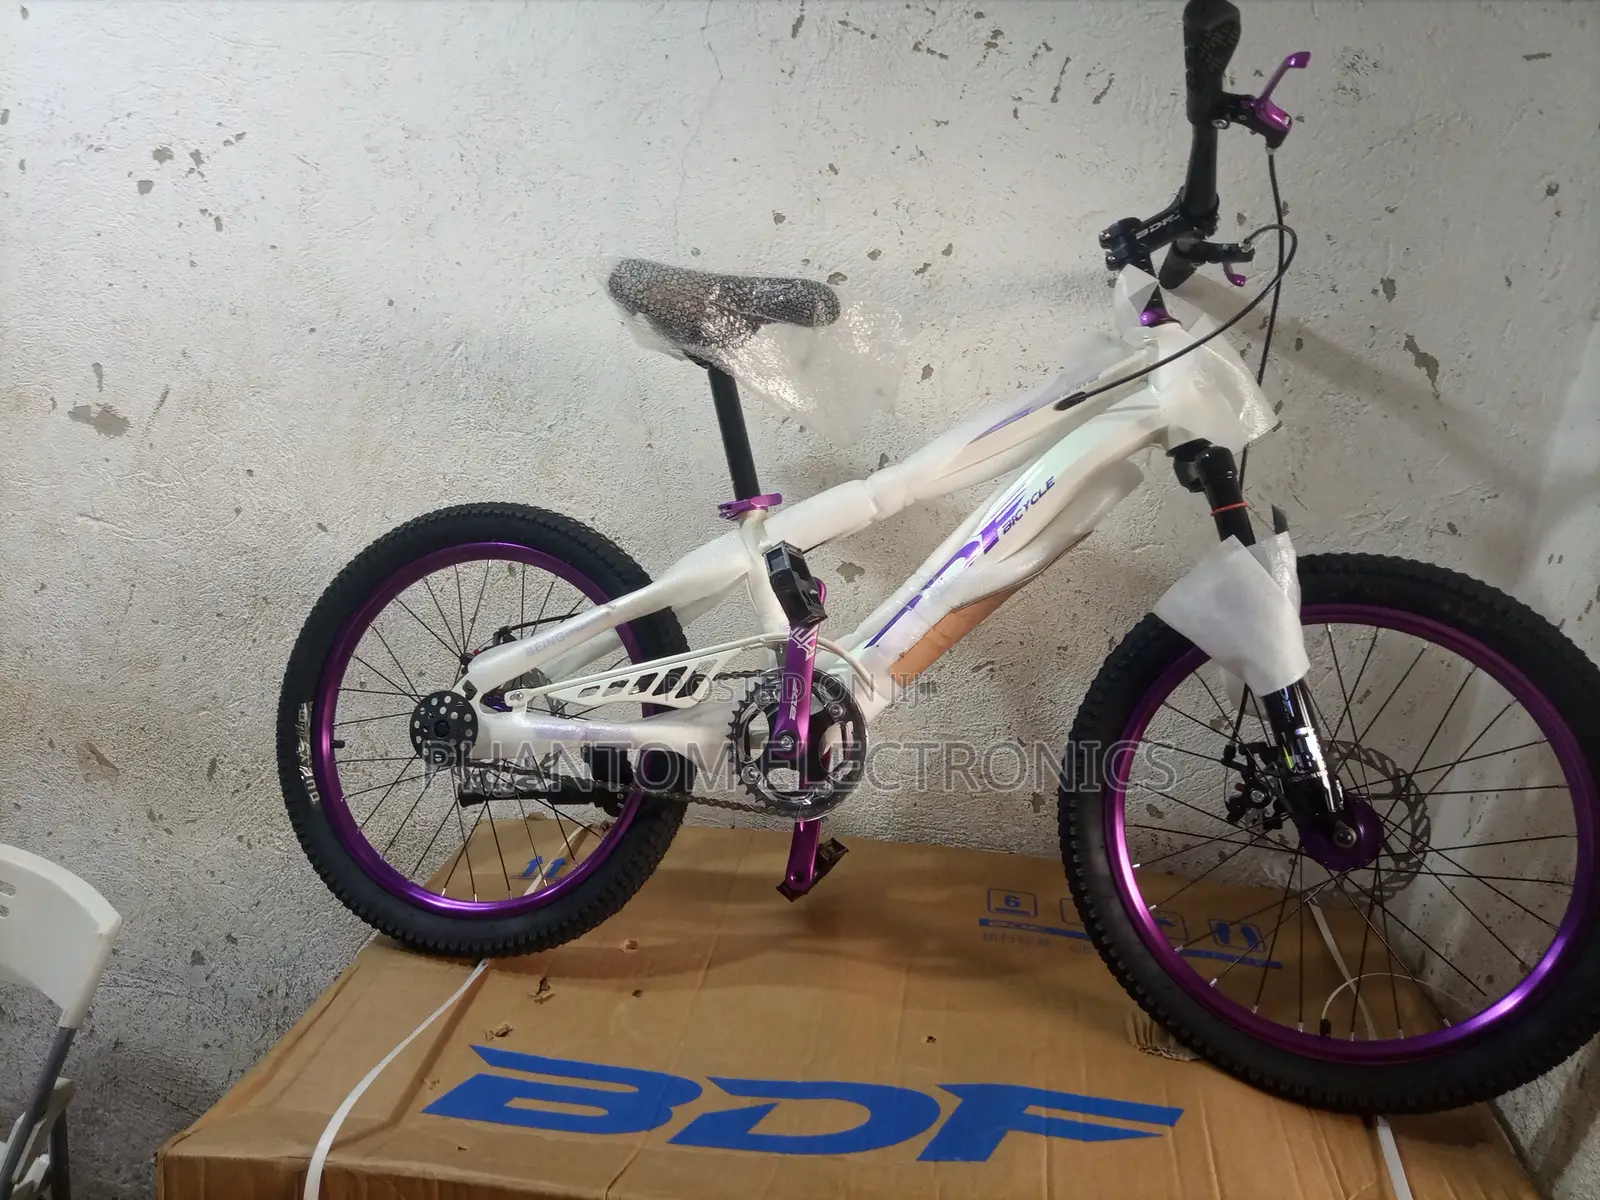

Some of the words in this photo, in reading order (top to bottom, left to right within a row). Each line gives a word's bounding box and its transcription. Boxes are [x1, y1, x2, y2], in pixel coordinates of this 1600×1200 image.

[1002, 475, 1056, 536] BICYCLE
[1004, 894, 1021, 908] 6
[421, 1044, 1184, 1162] BDF
